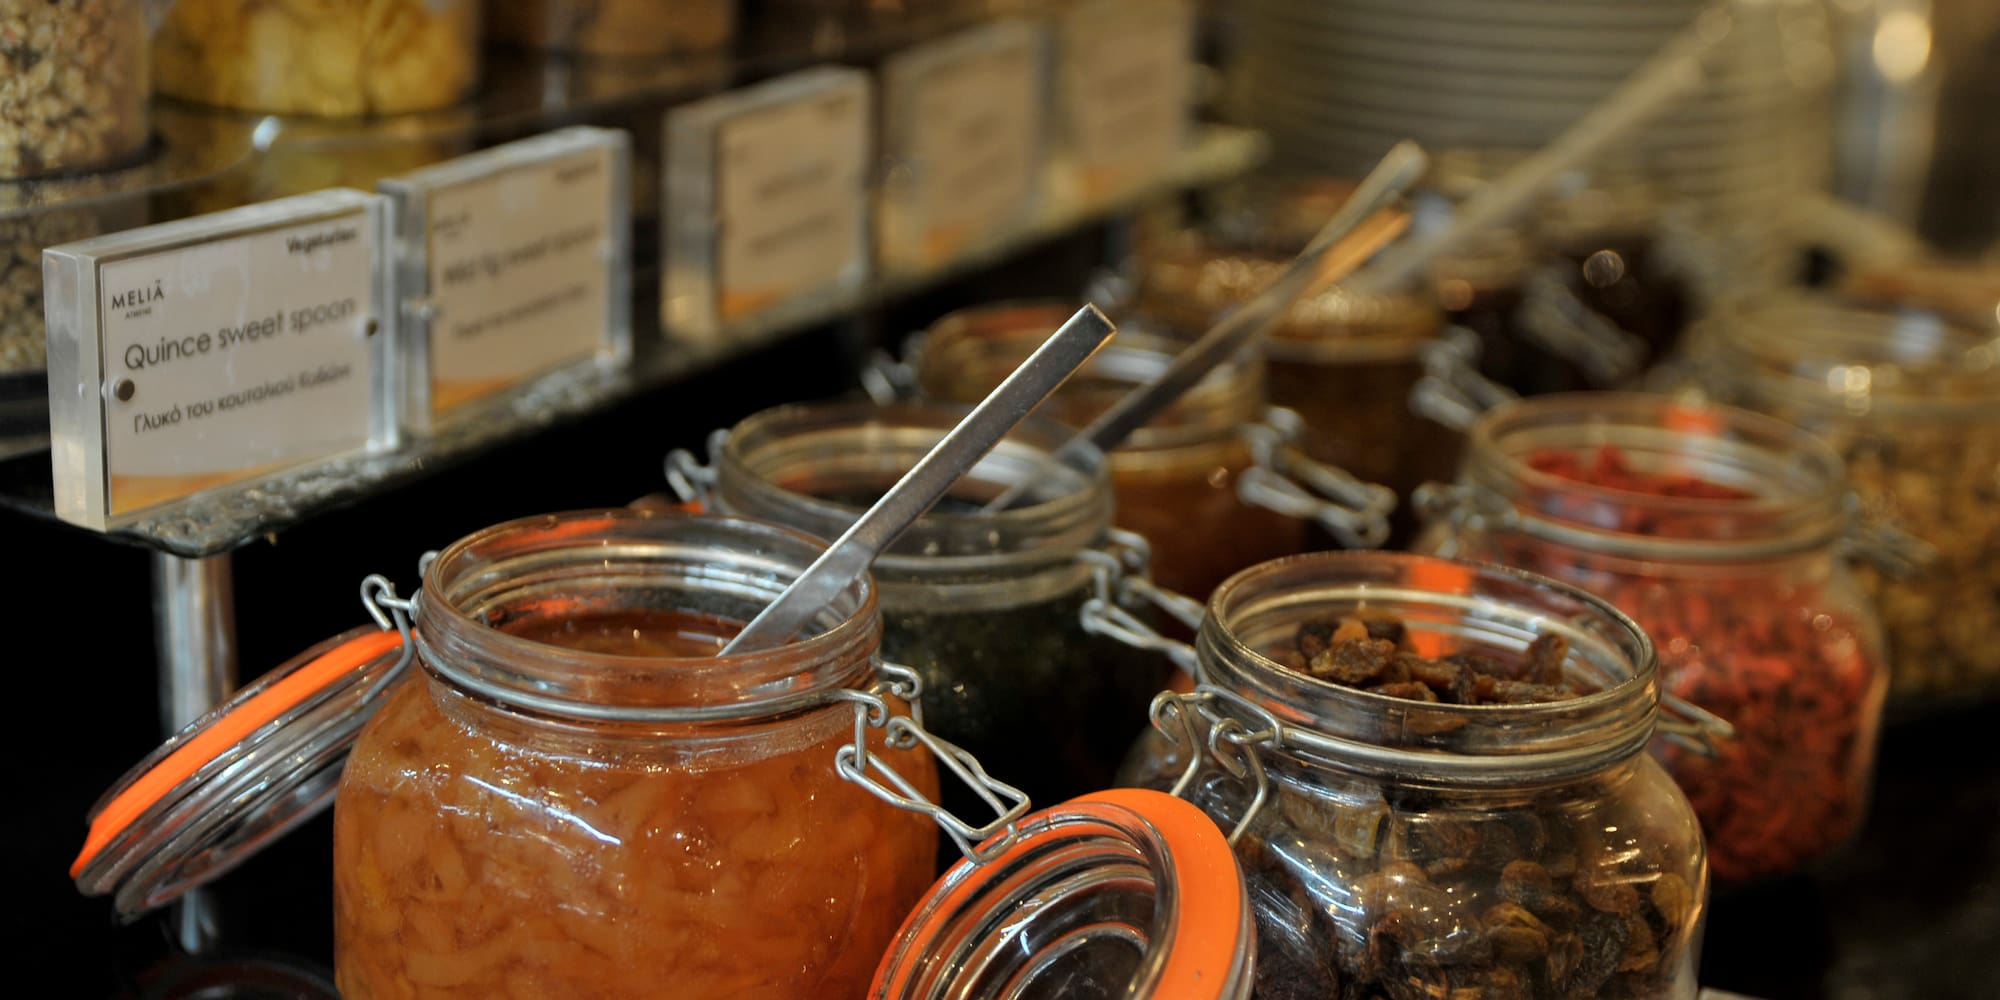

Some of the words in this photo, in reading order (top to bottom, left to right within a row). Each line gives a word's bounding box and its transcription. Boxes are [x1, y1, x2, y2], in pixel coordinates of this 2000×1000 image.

[124, 332, 212, 371] Quince
[218, 310, 284, 350] sweet
[289, 297, 356, 334] spoon
[134, 403, 181, 433] Γλυκό
[186, 399, 214, 420] του
